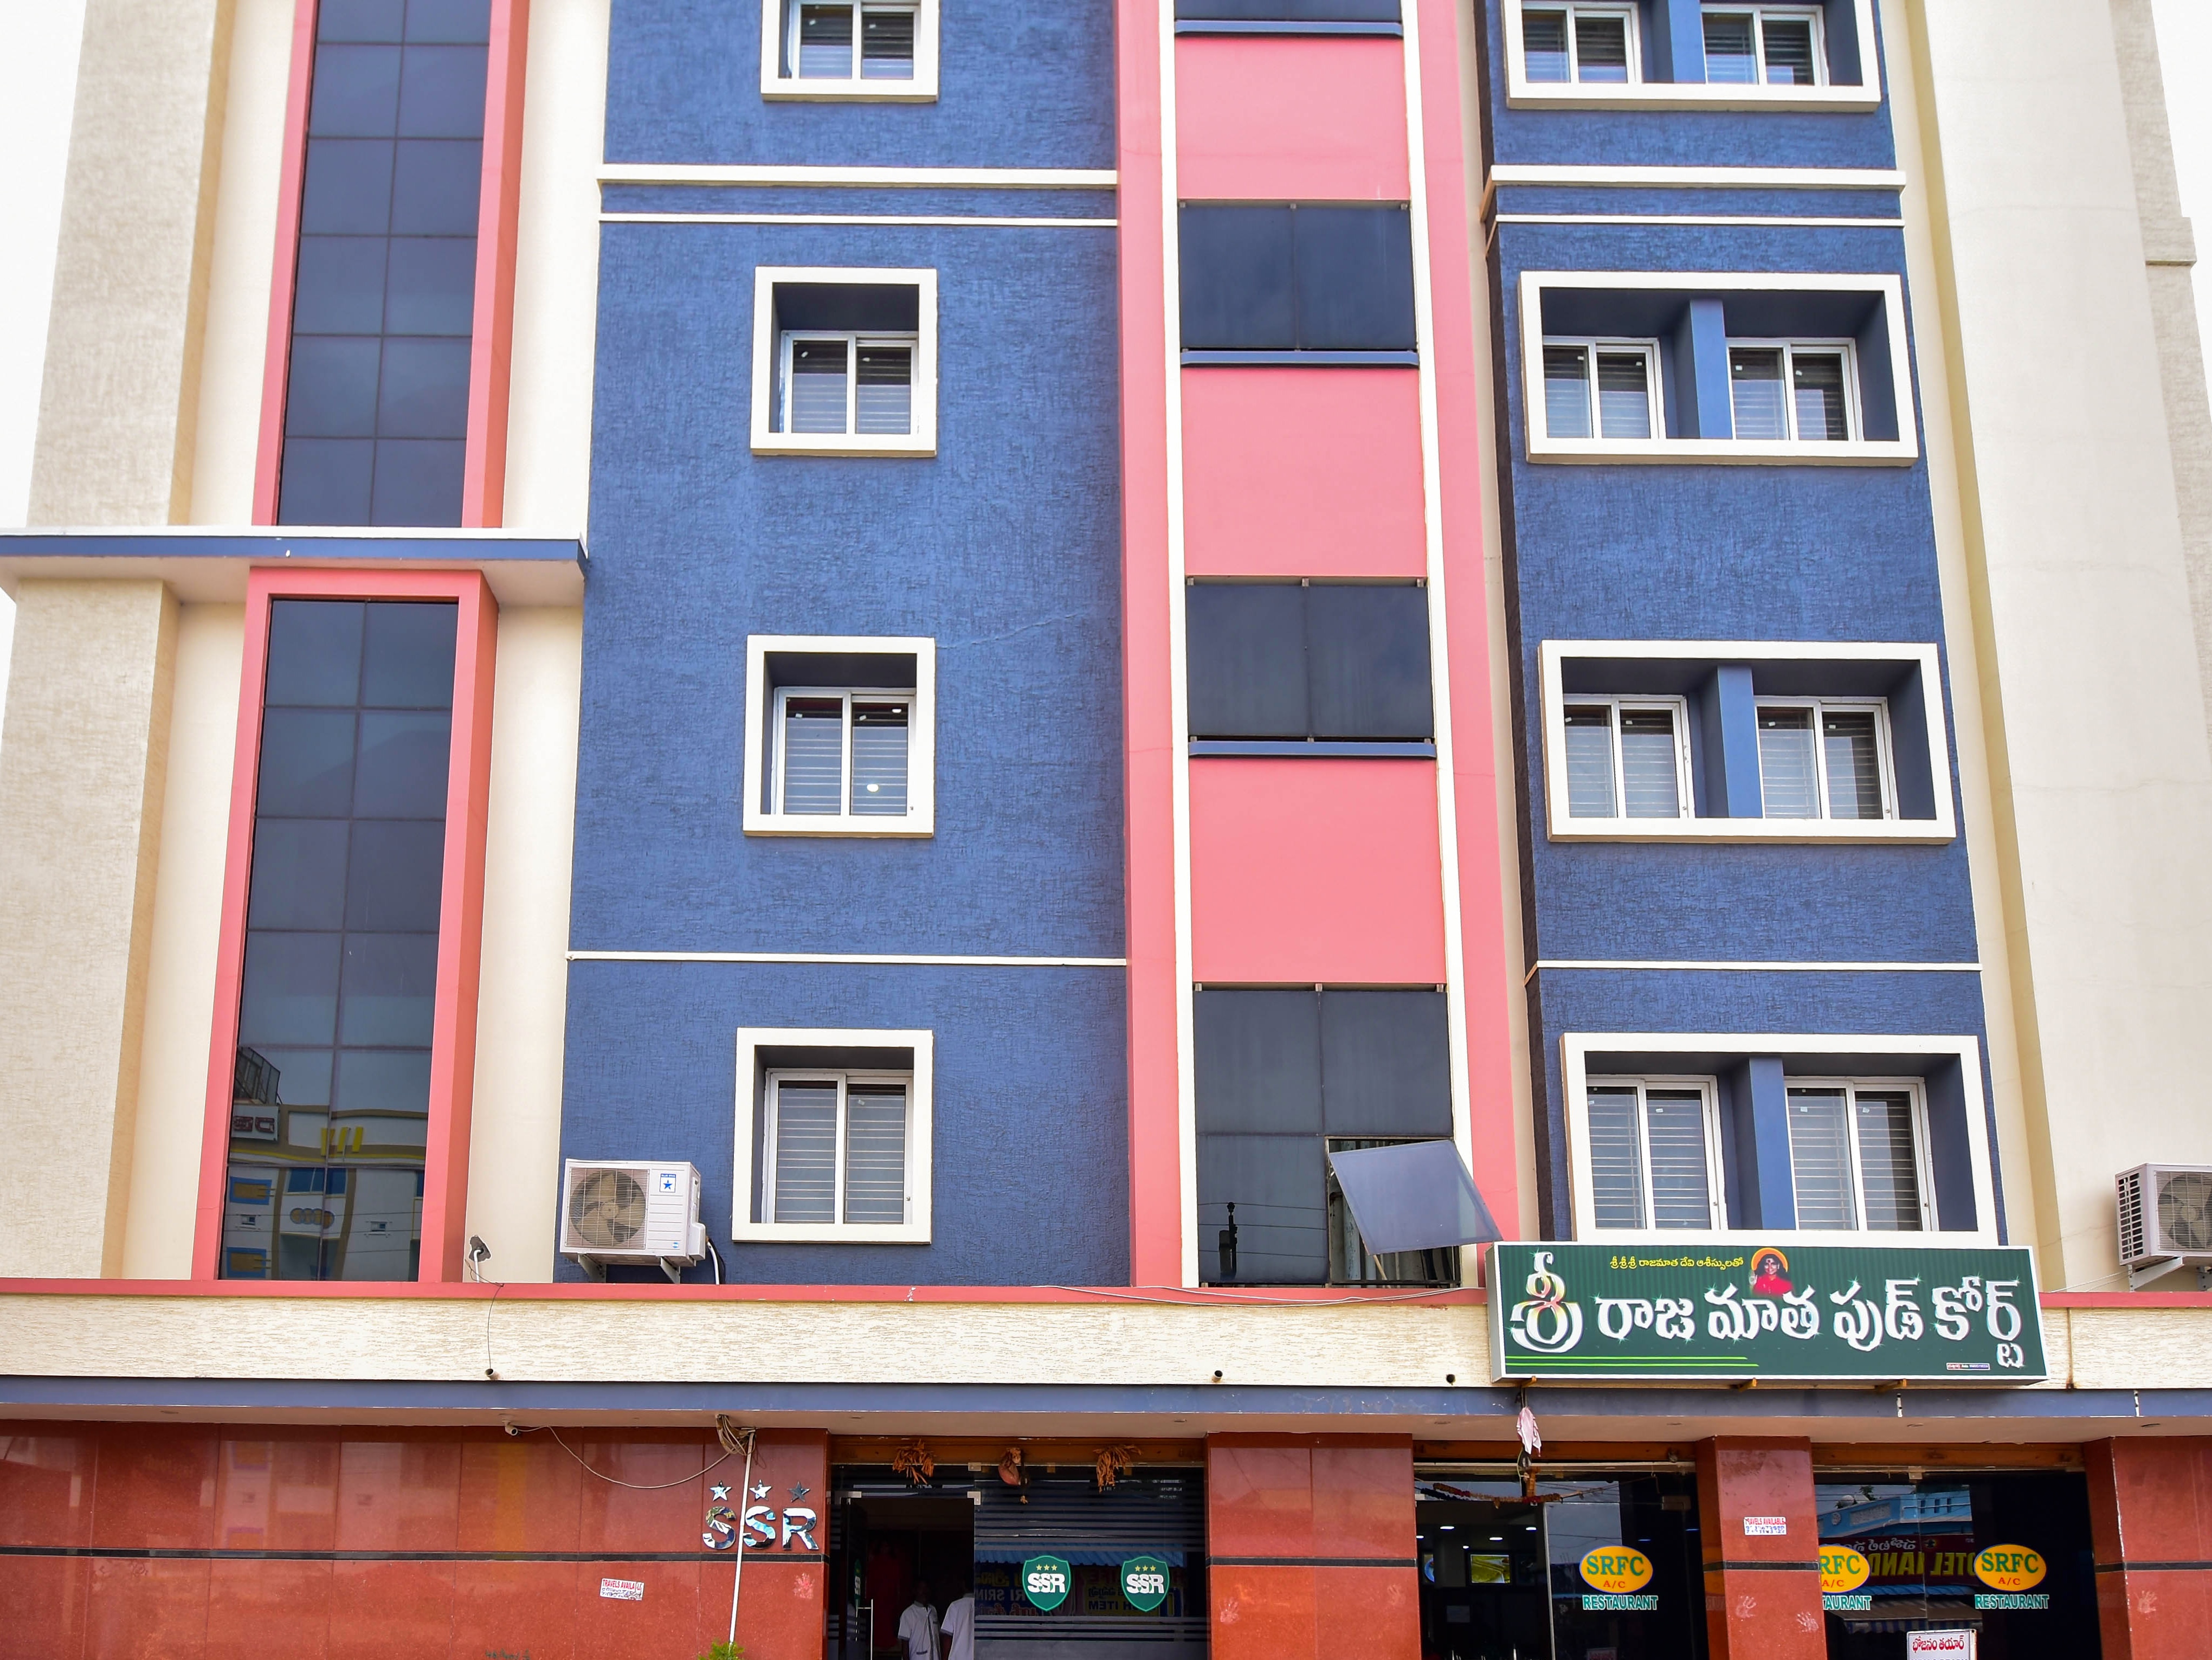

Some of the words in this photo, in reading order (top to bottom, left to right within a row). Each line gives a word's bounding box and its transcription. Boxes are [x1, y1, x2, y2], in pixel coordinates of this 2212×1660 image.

[1638, 1258, 1678, 1267] రాజమాత
[1680, 1256, 1694, 1267] దేవి
[1510, 1251, 1584, 1353] శ్రీ
[1595, 1297, 1696, 1340] రాజ
[1704, 1283, 1820, 1340] మాత
[702, 1505, 819, 1550] SSR
[1587, 1555, 1645, 1577] SRFC
[1820, 1555, 1861, 1575] RFC
[1981, 1552, 2039, 1574] SRFC
[603, 1579, 620, 1588] TRAVELS
[1027, 1573, 1066, 1593] SSR
[1126, 1574, 1164, 1594] SSR
[1603, 1580, 1626, 1588] A/C
[1821, 1579, 1845, 1588] A/C
[1998, 1577, 2021, 1586] A/C
[1582, 1595, 1659, 1610] RESTAURANT
[1974, 1594, 2049, 1609] RESTAURANT
[1912, 1636, 1937, 1653] భోజనం
